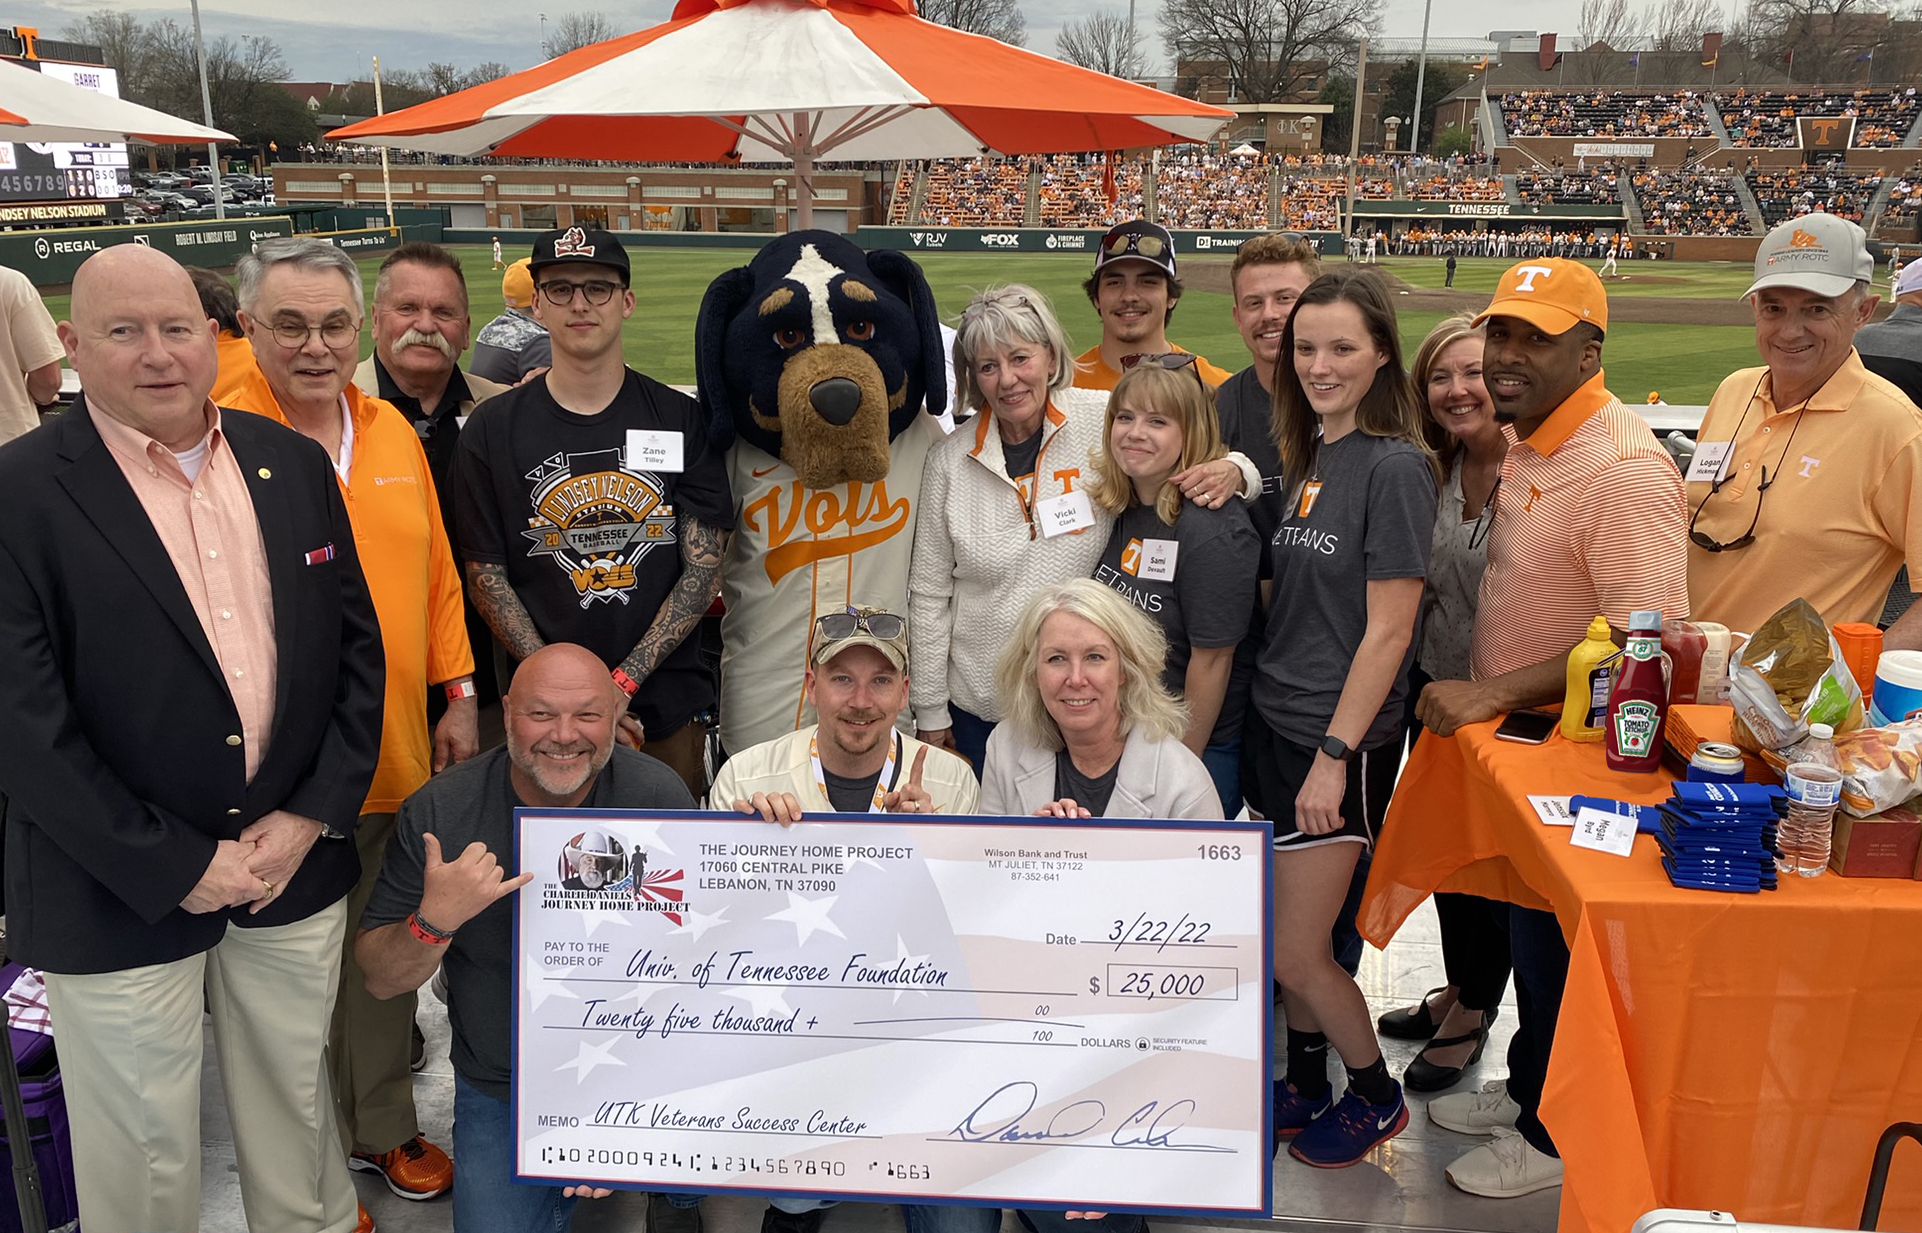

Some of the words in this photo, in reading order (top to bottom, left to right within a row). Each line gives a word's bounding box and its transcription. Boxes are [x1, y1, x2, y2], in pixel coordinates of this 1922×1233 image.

[12, 176, 21, 191] 5
[23, 176, 33, 191] 6
[34, 175, 42, 190] 7
[46, 175, 54, 190] 8
[56, 175, 64, 190] 9
[31, 206, 67, 219] NELSON
[68, 204, 107, 218] STADIUM
[1448, 204, 1511, 215] TENNESSEE
[926, 233, 947, 243] RJV
[988, 234, 1020, 245] FOX
[53, 240, 102, 253] REGAL
[1775, 253, 1801, 263] ARMY
[1801, 253, 1830, 262] ROTC
[1515, 266, 1552, 292] T
[643, 447, 666, 455] Zane
[1700, 459, 1721, 467] Logan
[544, 476, 599, 522] LINDSEY
[601, 475, 654, 514] NELSON
[742, 480, 893, 549] Vols
[1054, 507, 1077, 518] Vicki
[544, 533, 560, 547] 20
[570, 529, 629, 543] TENNESSEE
[646, 525, 663, 538] 22
[582, 540, 620, 548] BASEBALL
[1150, 556, 1166, 564] Sami
[1626, 706, 1649, 716] HEINZ
[1624, 719, 1650, 727] TOMATO
[1584, 821, 1595, 835] Byrd
[1595, 819, 1611, 842] Megan
[699, 844, 727, 856] THE
[731, 844, 798, 857] JOURNEY
[802, 846, 843, 858] HOME
[847, 847, 914, 859] PROJECT
[984, 848, 1016, 858] Wilson
[1018, 849, 1042, 858] Bank
[1044, 850, 1061, 858] and
[1063, 850, 1088, 859] Trust
[1197, 844, 1242, 860] 1663
[700, 862, 737, 873] 17060
[741, 862, 808, 874] CENTRAL
[811, 863, 844, 874] PIKE
[988, 860, 1003, 869] MT
[1005, 861, 1039, 871] JULIET,
[1041, 861, 1054, 870] TN
[1056, 862, 1083, 871] 37122
[1010, 872, 1060, 882] 87-352-641
[699, 878, 771, 892] LEBANON,
[775, 879, 793, 891] TN
[797, 880, 836, 892] 37090
[543, 890, 589, 899] CHARLIE
[589, 891, 632, 900] DANIELS
[541, 900, 595, 911] JOURNEY
[599, 901, 634, 911] HOME
[637, 902, 691, 912] PROJECT
[1045, 933, 1077, 946] Date
[1108, 912, 1211, 954] 3/22/22
[544, 942, 566, 952] PAY
[569, 942, 584, 952] TO
[587, 943, 610, 953] THE
[544, 956, 585, 966] ORDER
[588, 957, 604, 966] OF
[626, 949, 677, 979] Univ.
[692, 951, 717, 989] of
[726, 950, 830, 982] Tennessee
[841, 953, 949, 986] Foundation
[1089, 976, 1101, 996] $
[1120, 972, 1205, 1000] 25,000
[1034, 1005, 1050, 1016] 00
[582, 999, 655, 1039] Twenty
[661, 1002, 701, 1039] five
[712, 1005, 801, 1033] thousand
[1032, 1030, 1054, 1042] 100
[1081, 1037, 1131, 1049] DOLLARS
[1152, 1038, 1181, 1046] SECURITY
[1181, 1038, 1208, 1046] FEATURE
[537, 1115, 579, 1128] MEMO
[594, 1101, 646, 1125] UTK
[650, 1103, 726, 1129] Veterans
[731, 1106, 800, 1132] Success
[806, 1109, 867, 1134] Center
